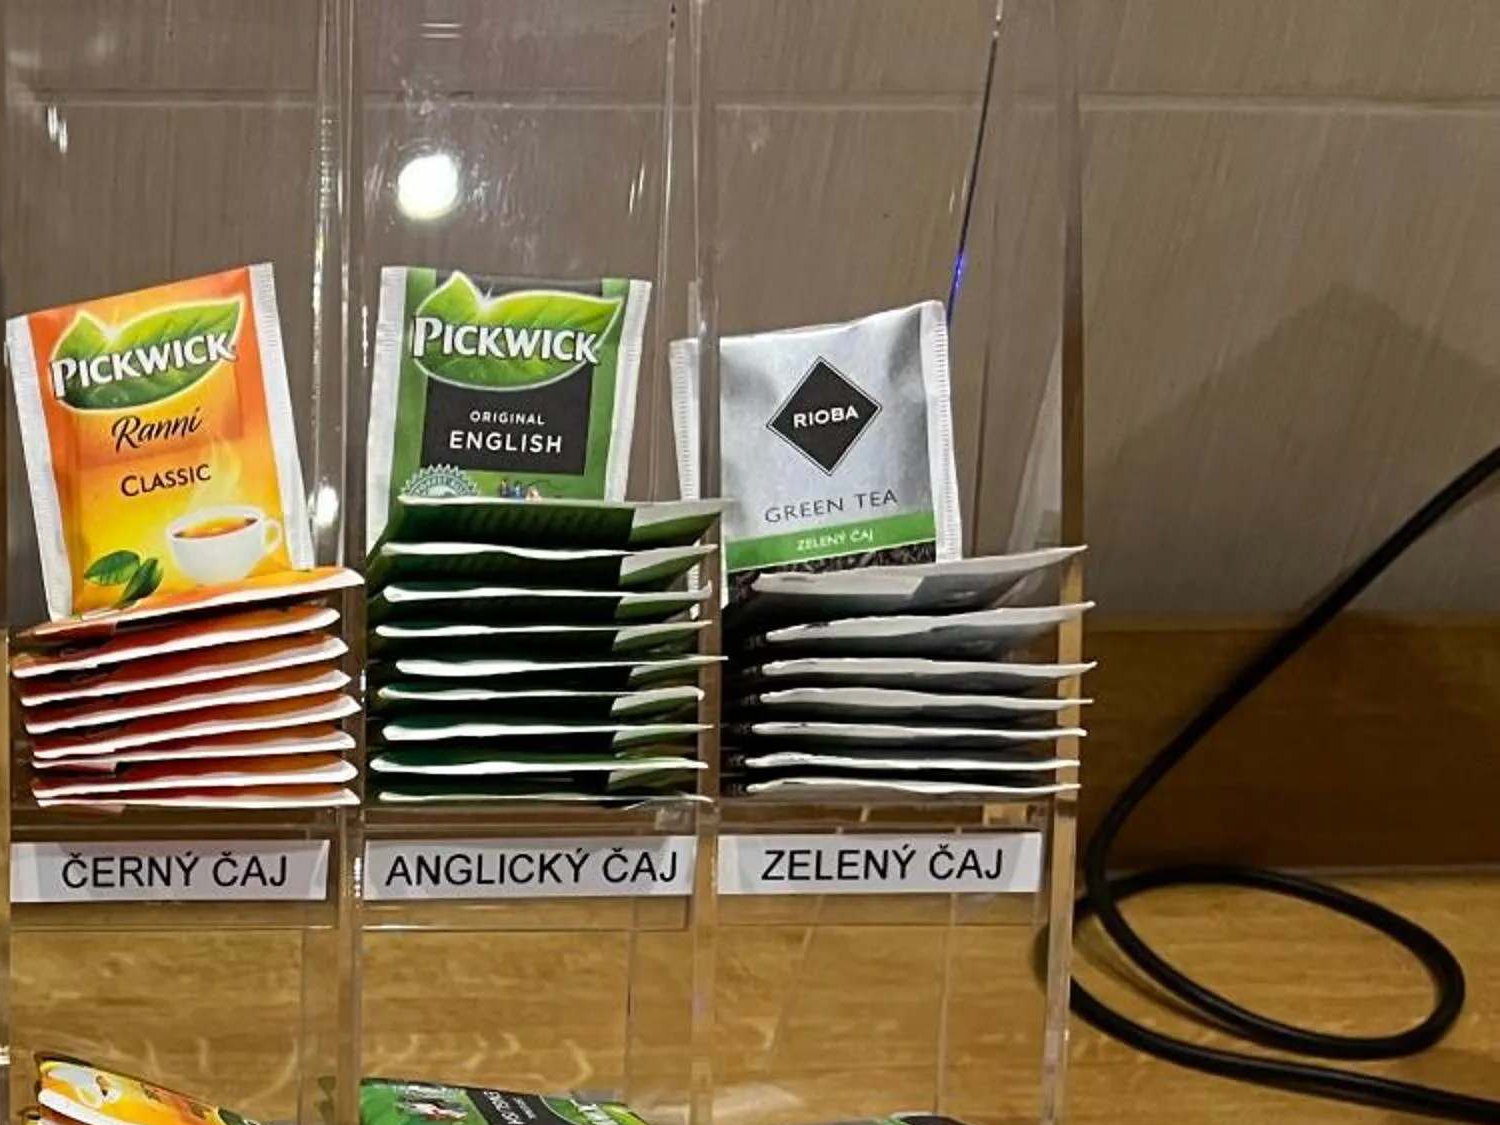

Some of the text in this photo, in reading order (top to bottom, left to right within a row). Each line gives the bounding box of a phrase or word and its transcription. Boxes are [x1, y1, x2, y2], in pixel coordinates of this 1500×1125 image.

[411, 316, 600, 366] PICKWICK
[50, 331, 238, 398] PICKWICK
[111, 406, 203, 454] Ranní
[469, 409, 546, 426] ORIGINAL
[792, 405, 861, 430] RIOBA
[449, 429, 563, 454] ENGLISH
[763, 488, 899, 524] GREEN TEA
[796, 526, 874, 551] ZELENÝ ČAJ
[61, 851, 288, 888] ČERNÝ ČAJ
[384, 847, 678, 887] ANGLICKÝ ČAJ
[760, 843, 1004, 882] ZELENÝ ČAJ
